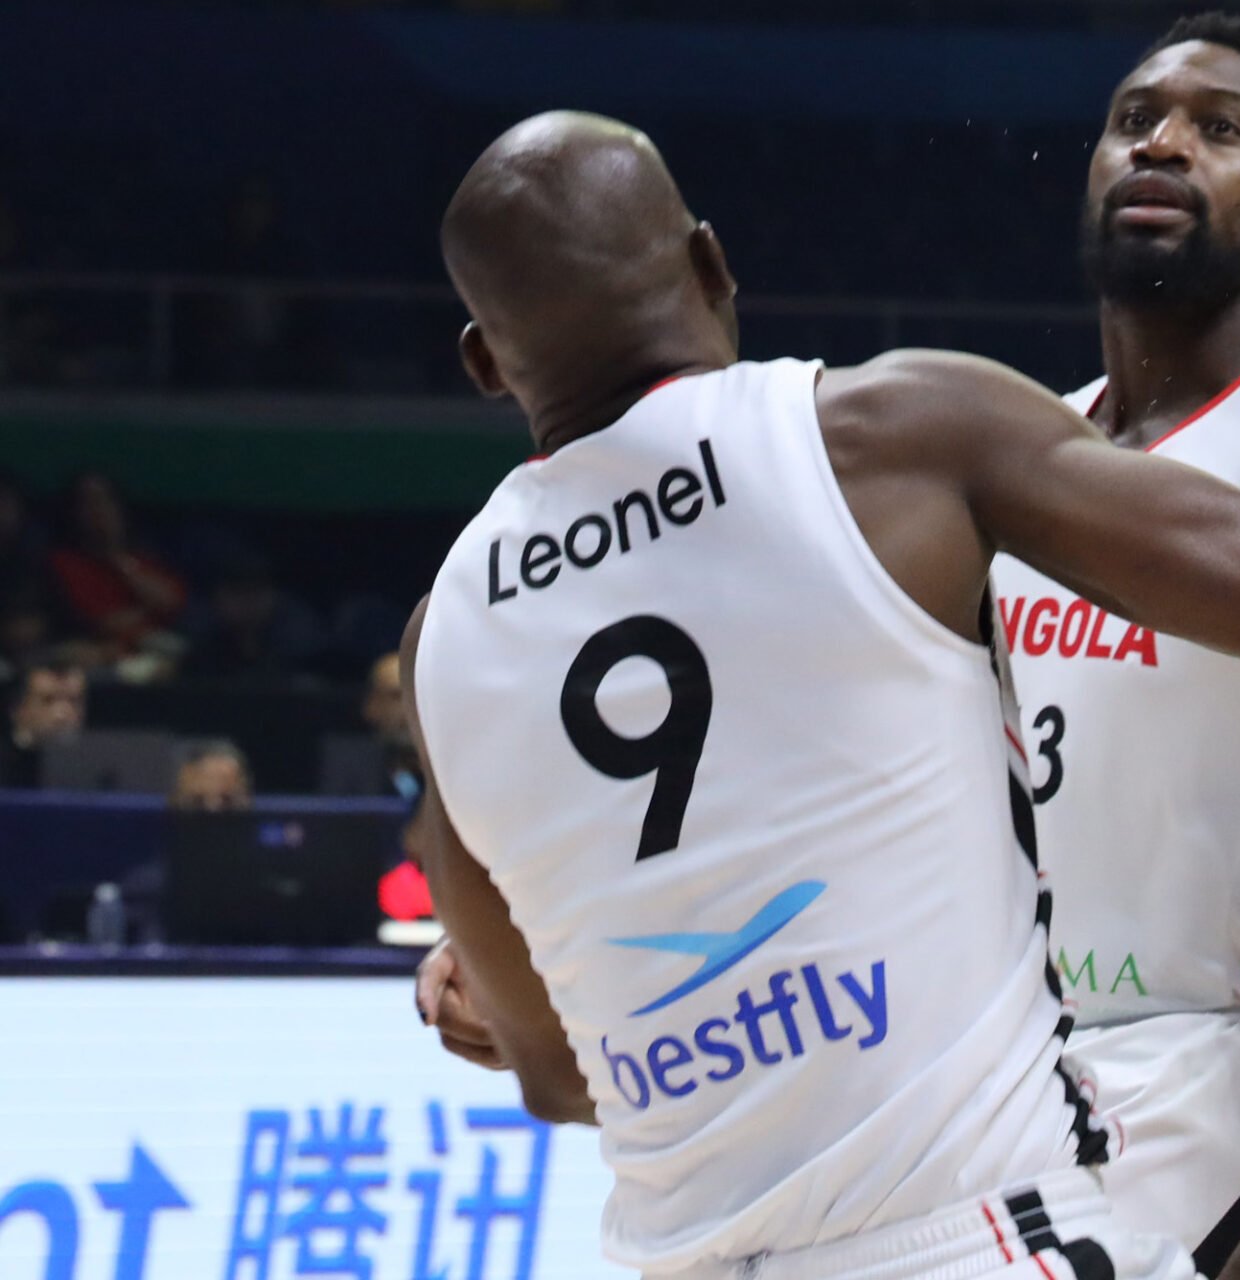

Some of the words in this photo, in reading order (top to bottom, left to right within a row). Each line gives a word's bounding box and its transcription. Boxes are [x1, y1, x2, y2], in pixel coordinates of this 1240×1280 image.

[488, 438, 727, 606] Leonel
[998, 596, 1159, 667] NGOLA
[559, 613, 713, 864] 9
[600, 957, 889, 1111] bestfly
